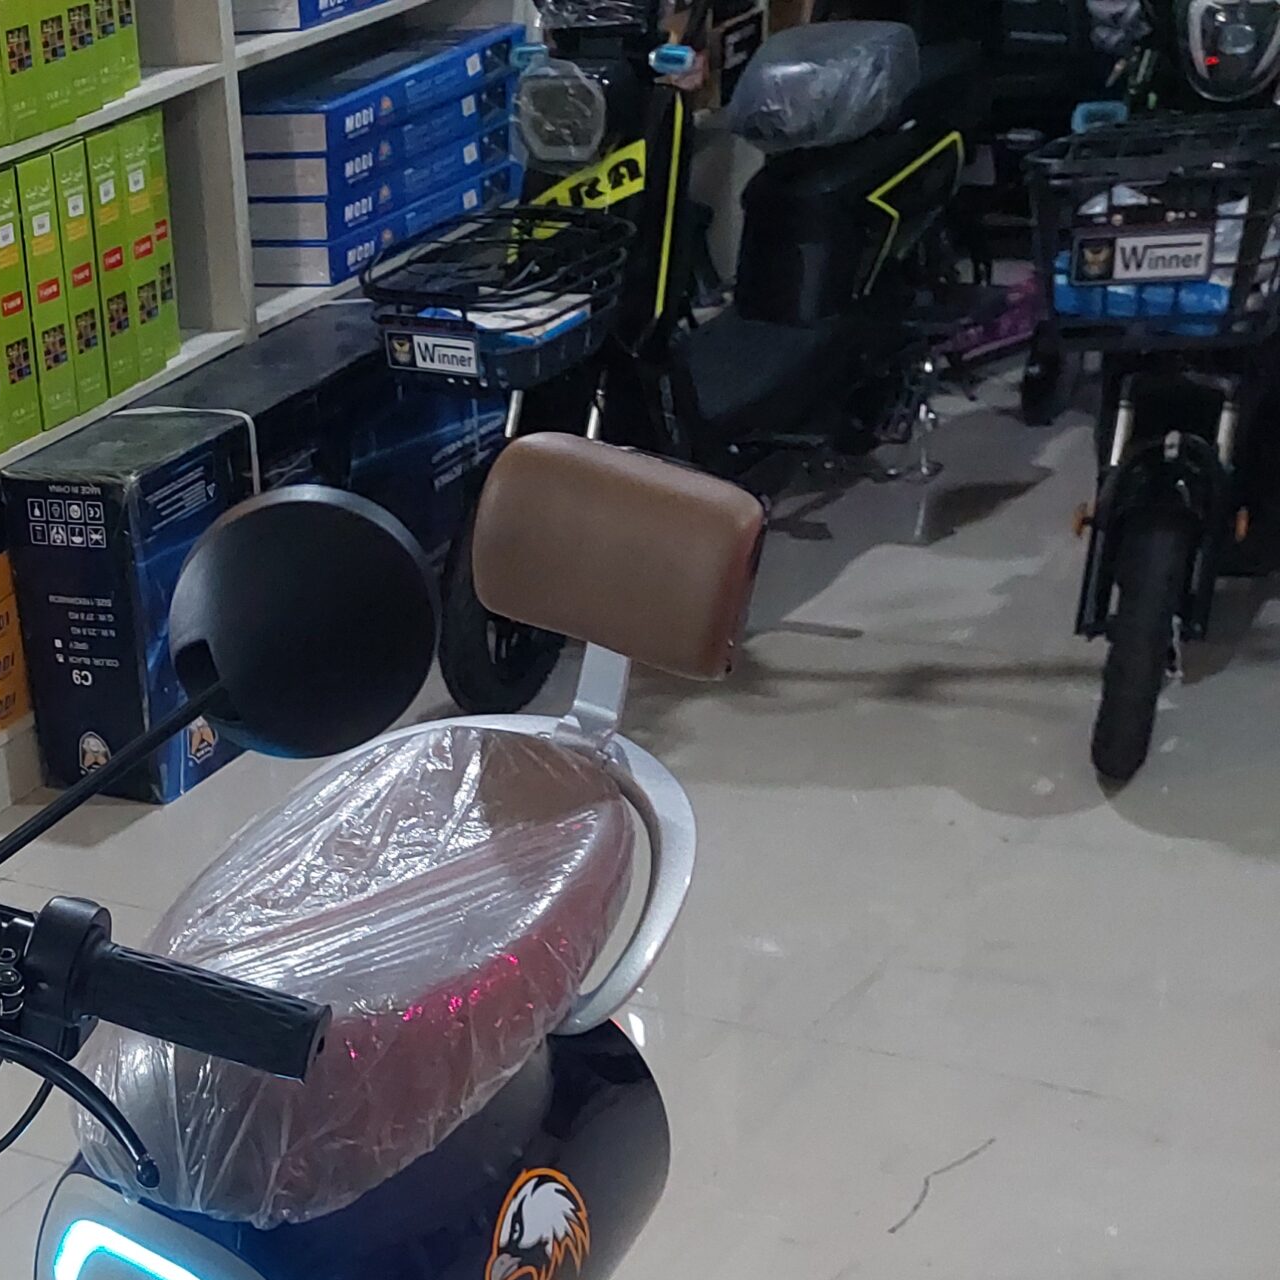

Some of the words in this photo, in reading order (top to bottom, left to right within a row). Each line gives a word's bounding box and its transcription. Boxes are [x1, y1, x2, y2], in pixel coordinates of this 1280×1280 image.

[1120, 242, 1203, 272] Winner
[416, 341, 473, 368] Winner
[72, 669, 92, 686] C9
